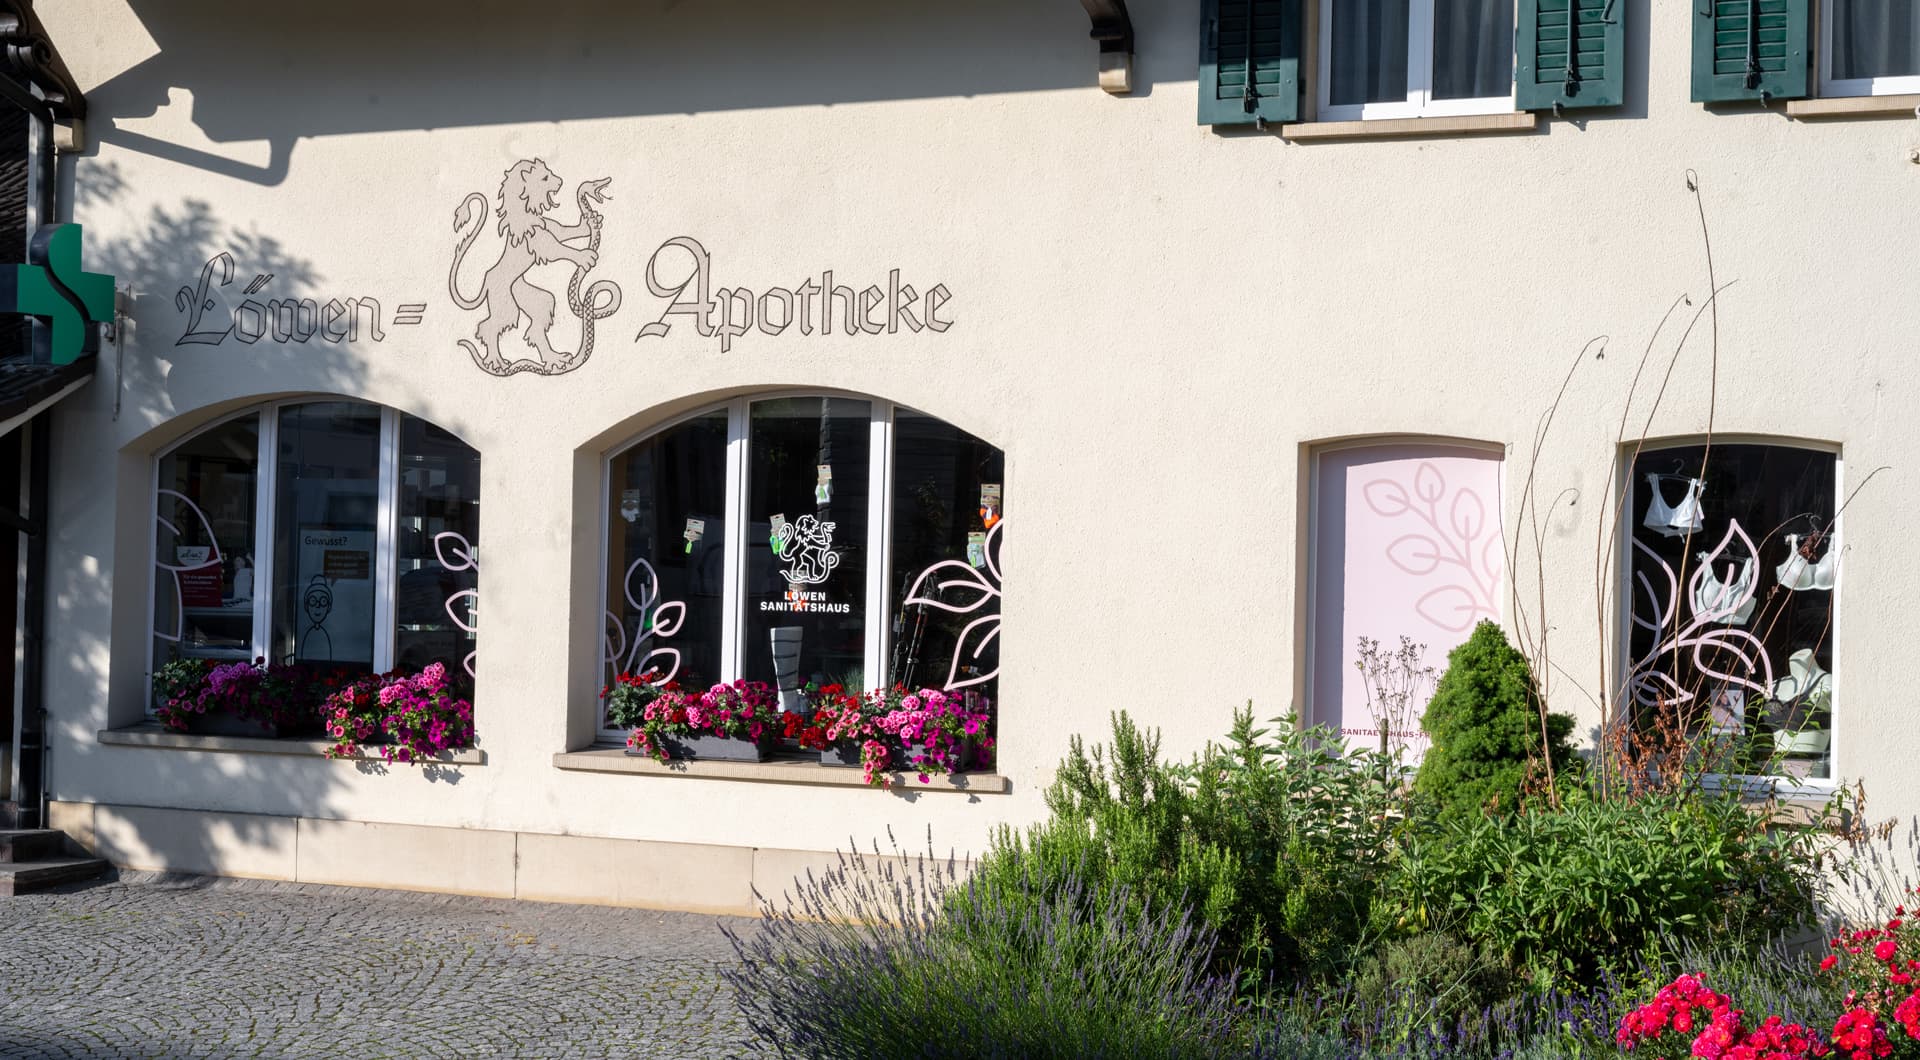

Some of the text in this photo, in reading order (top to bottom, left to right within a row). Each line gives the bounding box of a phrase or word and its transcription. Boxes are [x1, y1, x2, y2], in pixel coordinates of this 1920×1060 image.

[634, 235, 955, 354] Apotheke
[304, 535, 348, 546] Gewusst?
[760, 600, 850, 613] SANITÄTSHAUS
